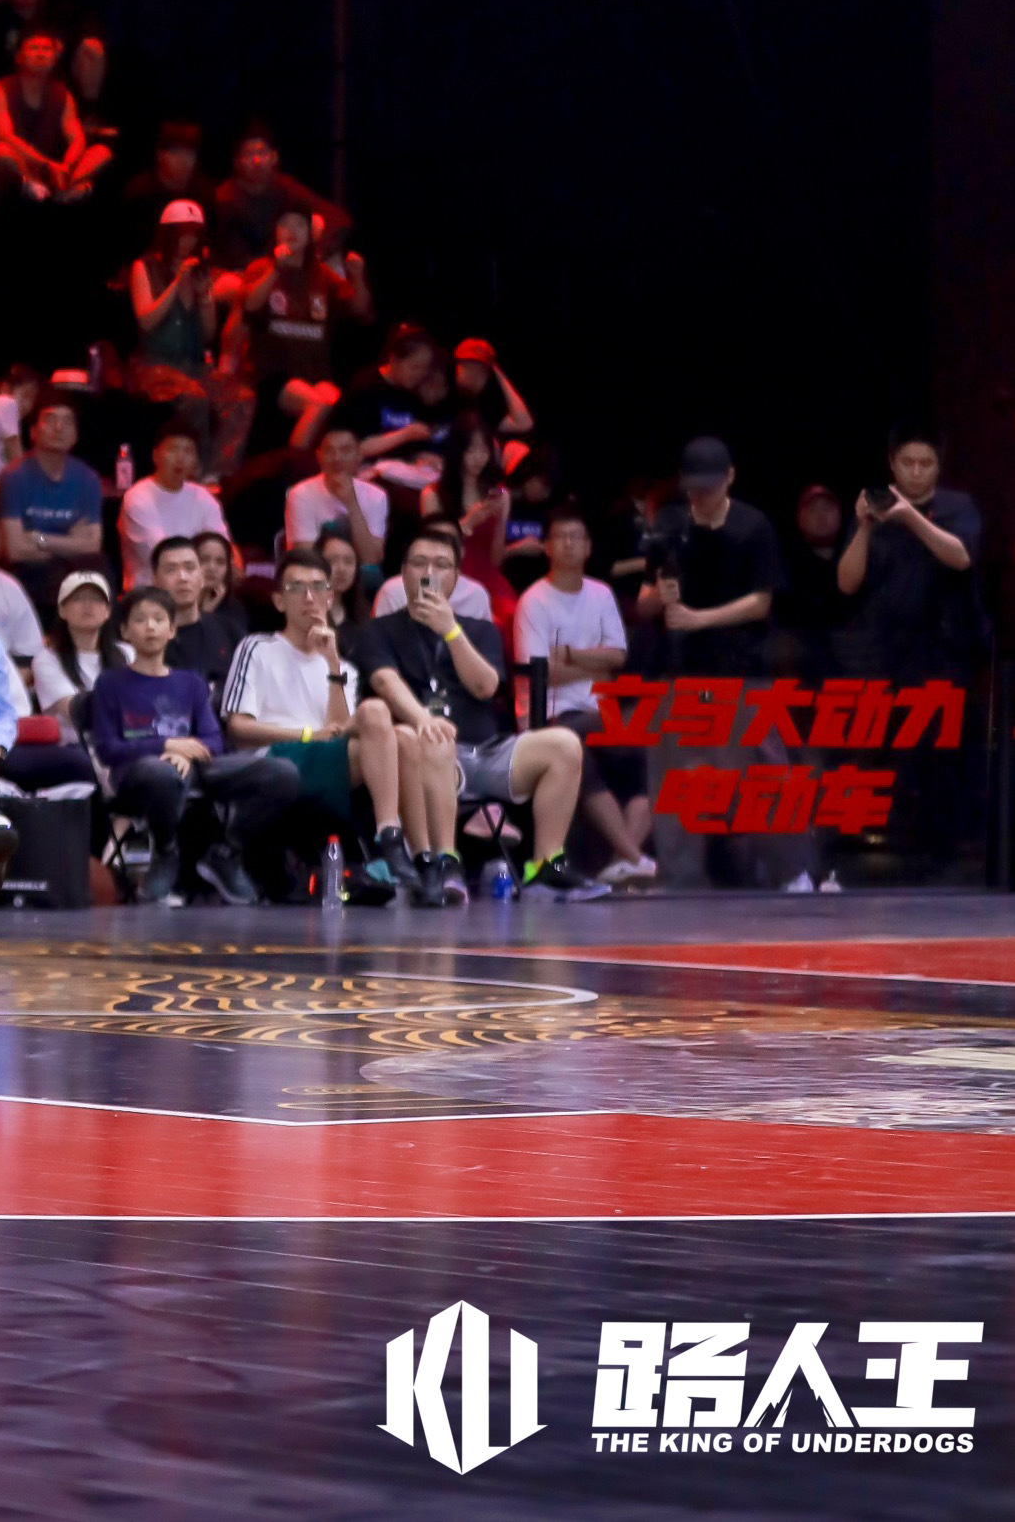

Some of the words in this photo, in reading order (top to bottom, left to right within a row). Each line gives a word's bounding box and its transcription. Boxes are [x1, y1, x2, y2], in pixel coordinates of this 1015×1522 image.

[586, 675, 966, 749] 立马大动力
[654, 764, 897, 835] 电动车
